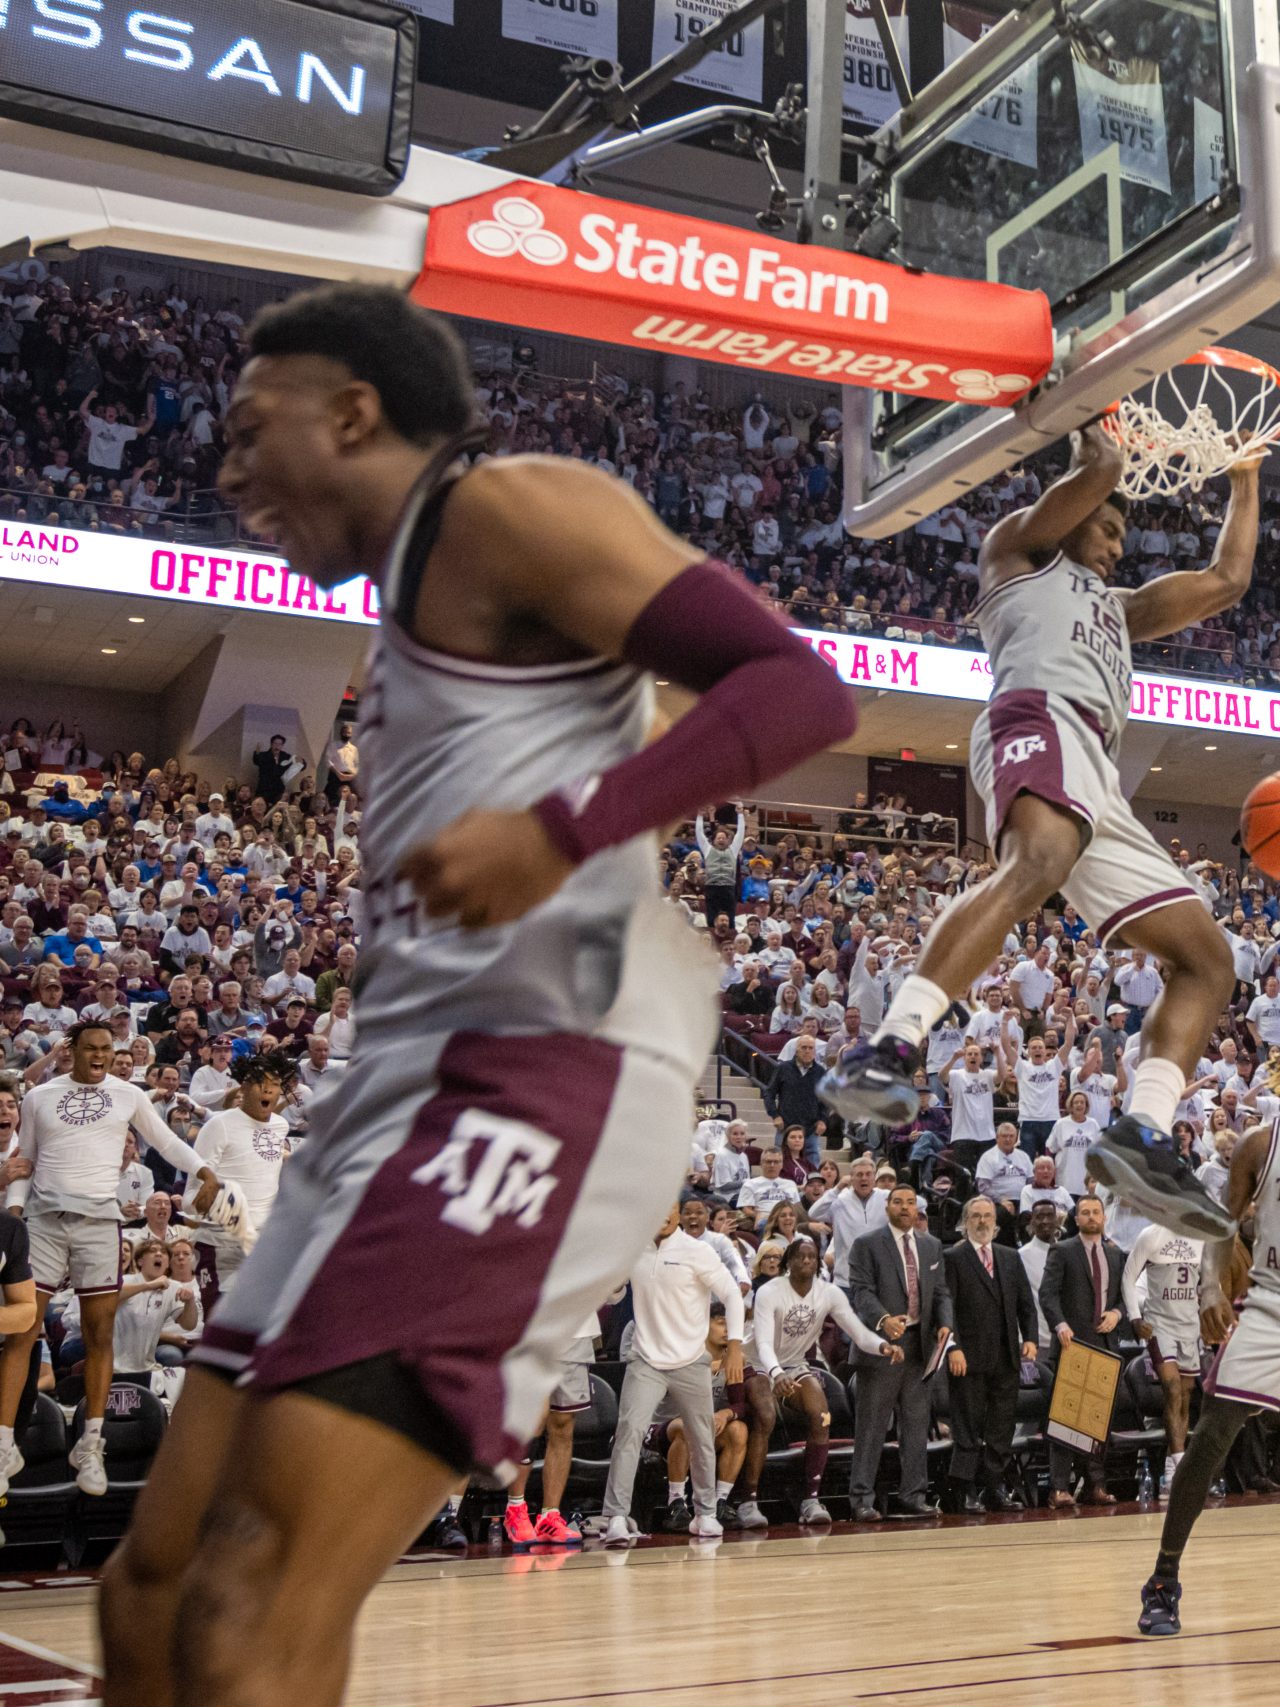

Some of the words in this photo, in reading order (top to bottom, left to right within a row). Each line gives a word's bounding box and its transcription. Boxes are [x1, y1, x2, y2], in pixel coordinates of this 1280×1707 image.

[843, 56, 893, 92] 980
[977, 95, 1022, 126] 76
[1097, 114, 1156, 154] 1975
[10, 558, 60, 575] UNION
[150, 549, 347, 615] OFFICIAL
[851, 640, 921, 688] A&M
[1129, 680, 1260, 730] OFFICIAL
[1154, 810, 1178, 823] 122
[59, 1110, 110, 1126] BASKETBALL
[1177, 1266, 1189, 1285] 3
